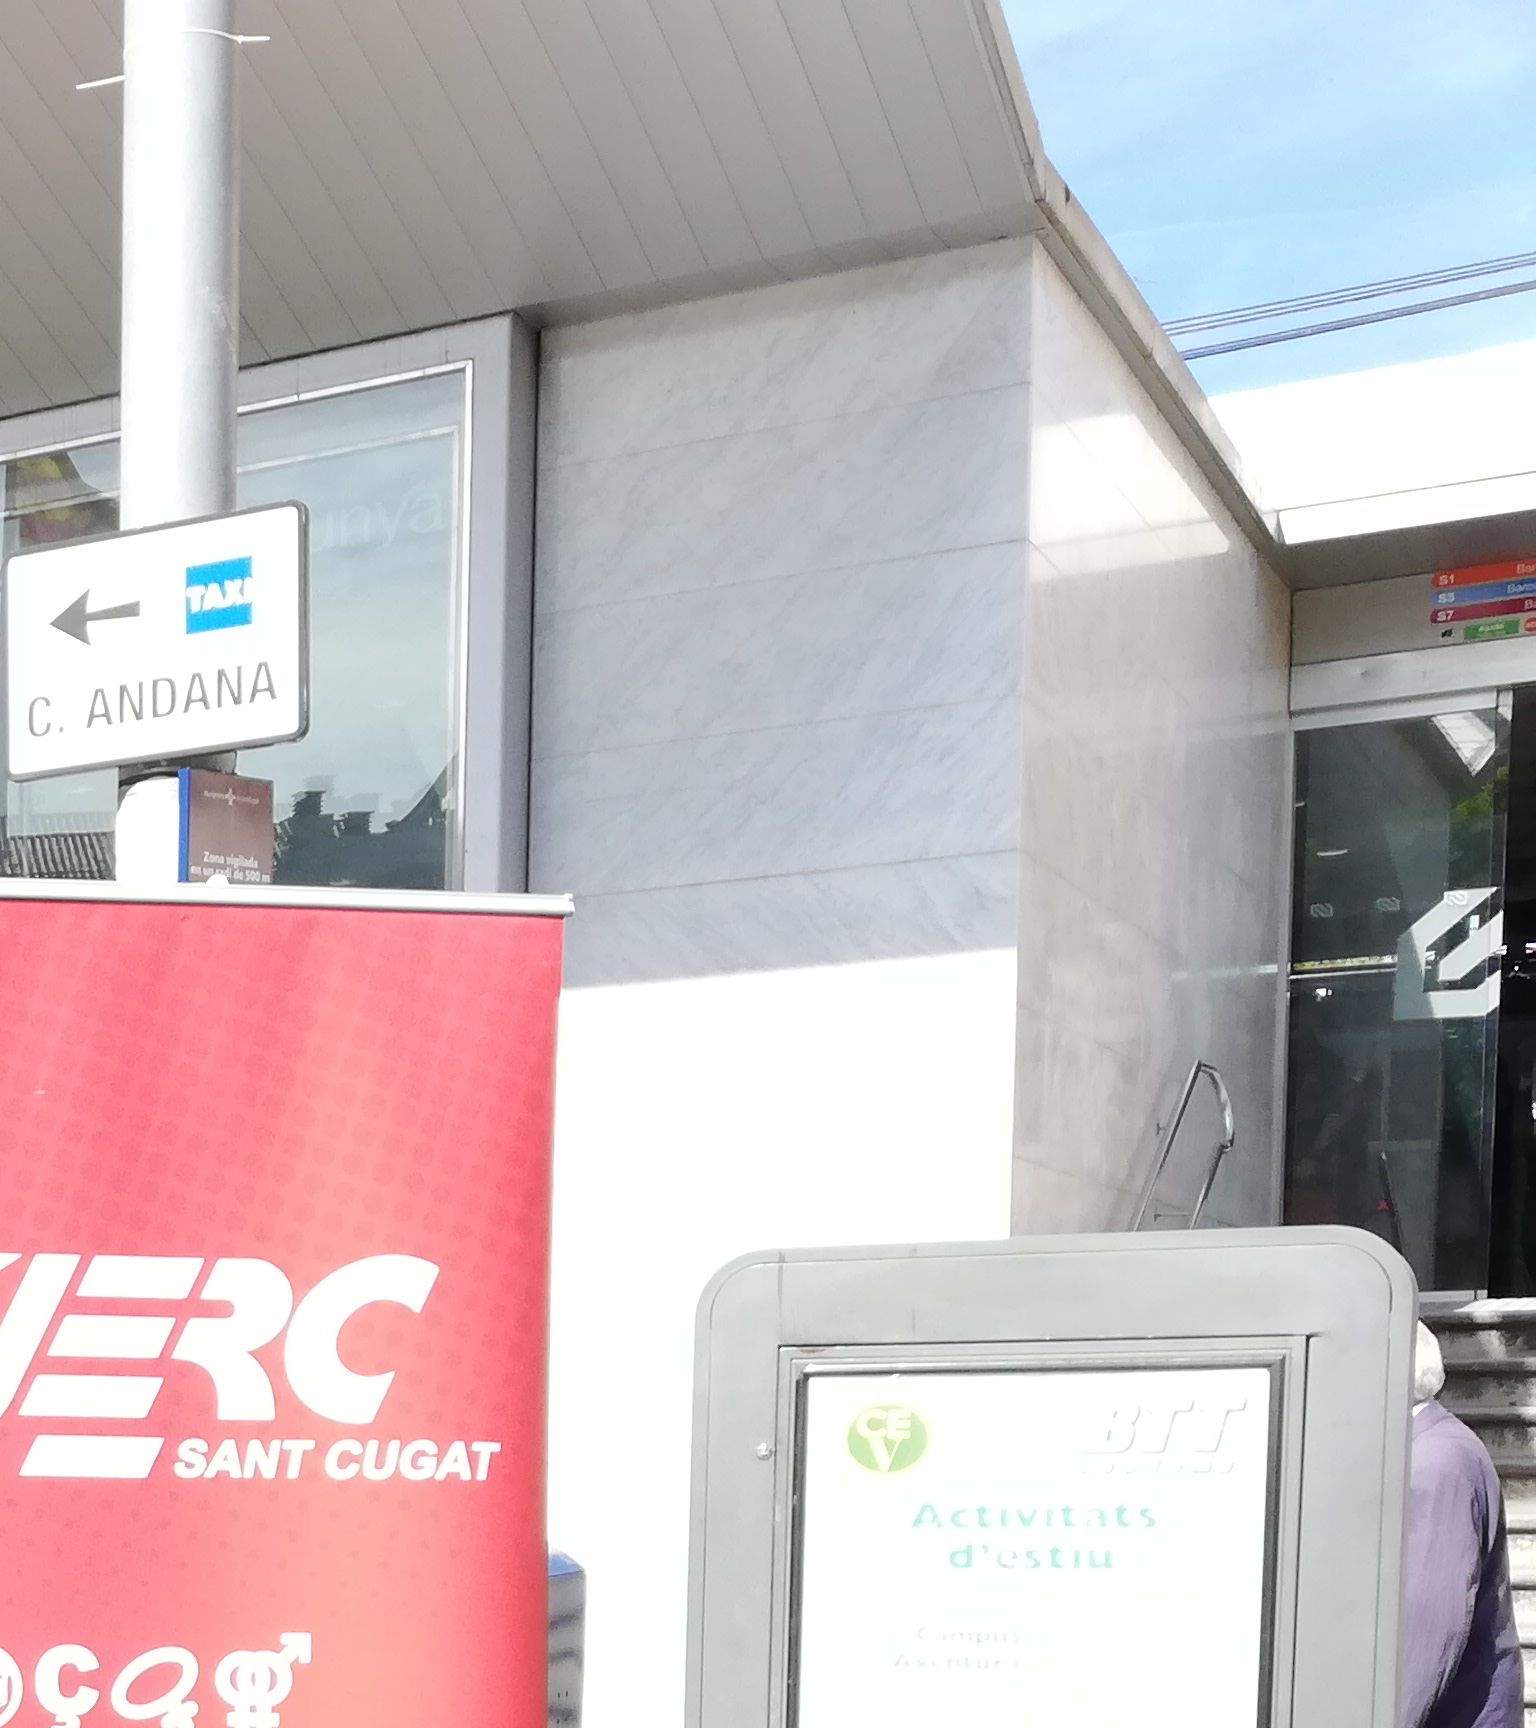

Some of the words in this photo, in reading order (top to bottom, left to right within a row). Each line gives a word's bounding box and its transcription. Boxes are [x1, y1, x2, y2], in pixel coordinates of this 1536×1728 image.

[1437, 610, 1455, 621] S7
[27, 696, 65, 739] C.
[87, 662, 277, 729] ANDANA
[173, 1437, 315, 1481] SANT
[324, 1441, 501, 1483] CUGAT
[911, 1501, 1158, 1531] Activitats
[949, 1541, 1115, 1570] d'estiu
